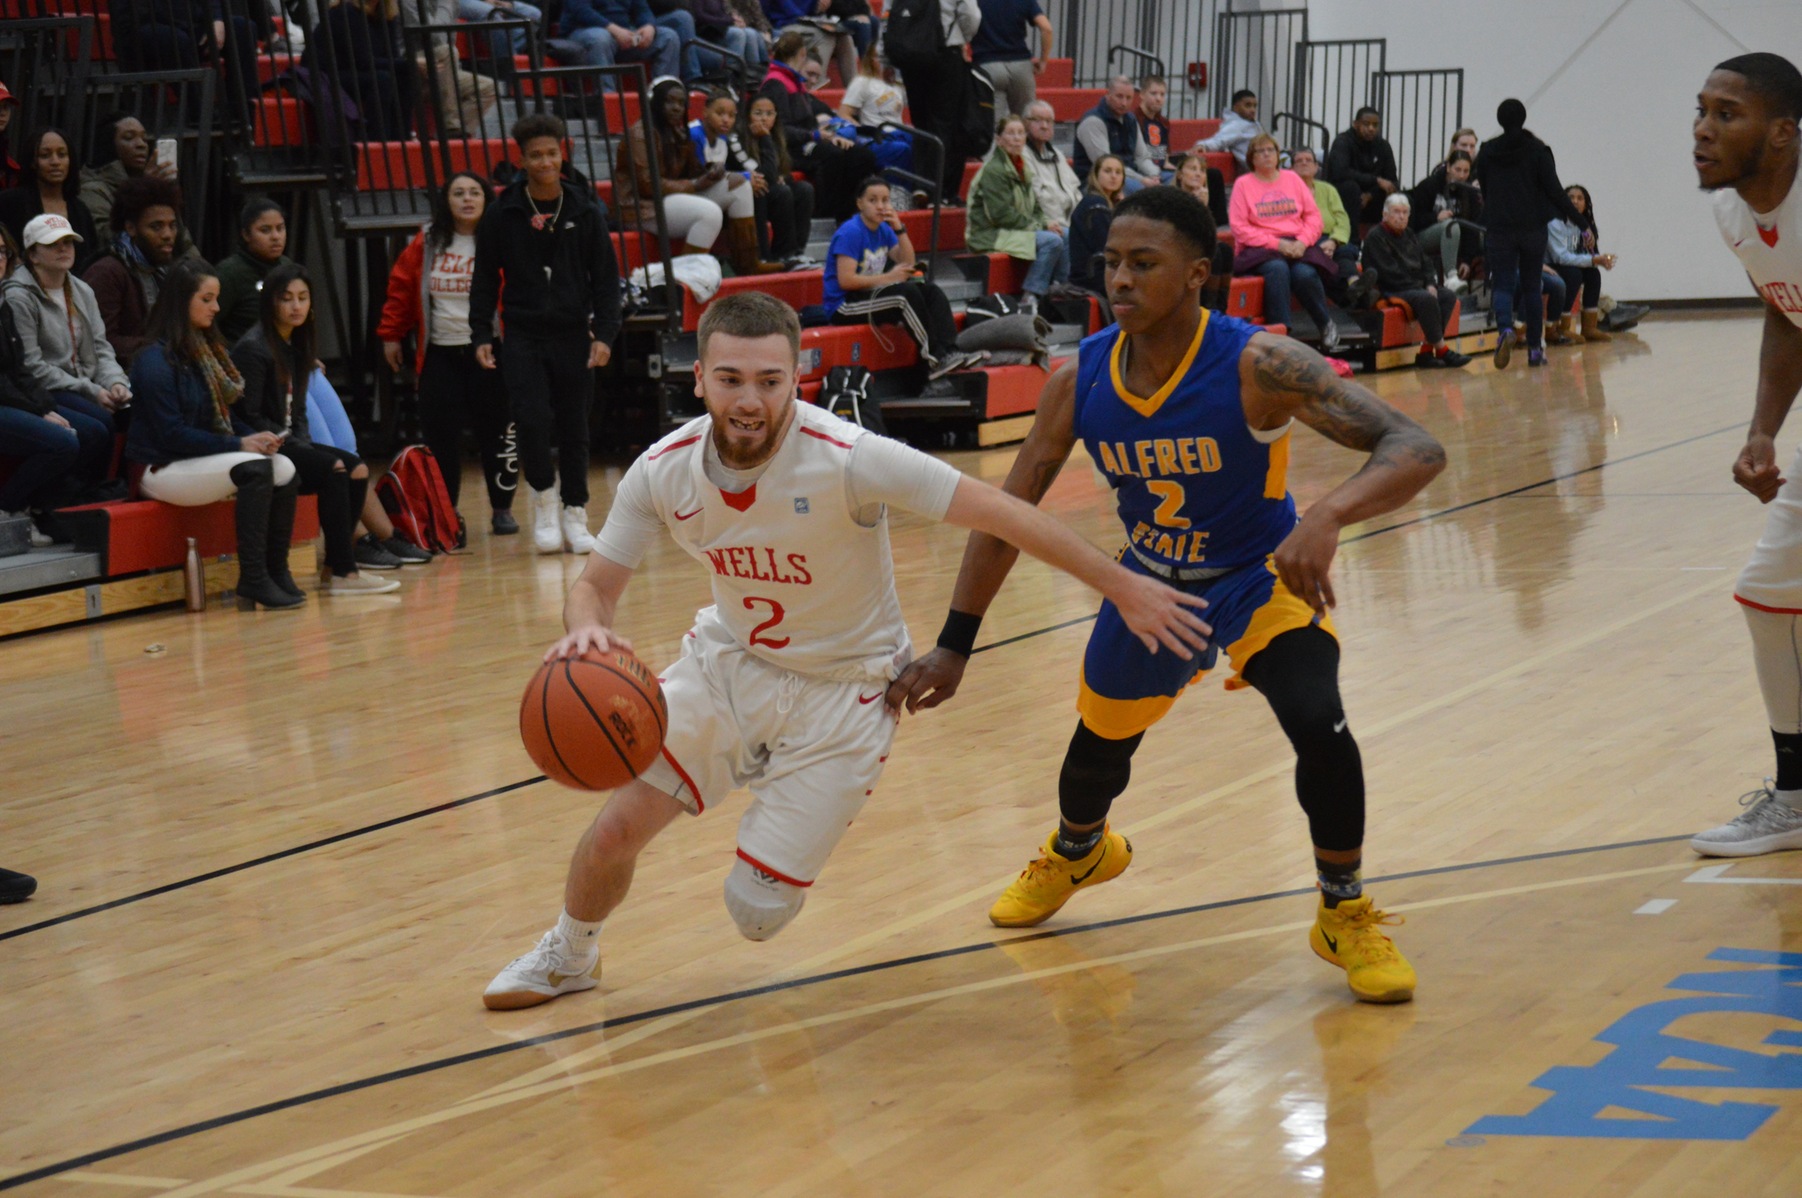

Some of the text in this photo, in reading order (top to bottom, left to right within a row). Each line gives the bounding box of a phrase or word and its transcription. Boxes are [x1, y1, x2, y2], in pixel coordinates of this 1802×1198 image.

[1148, 123, 1161, 147] S
[1099, 436, 1222, 478] ALFRED
[1146, 480, 1191, 530] 2
[702, 546, 813, 586] WELLS
[743, 596, 791, 649] 2
